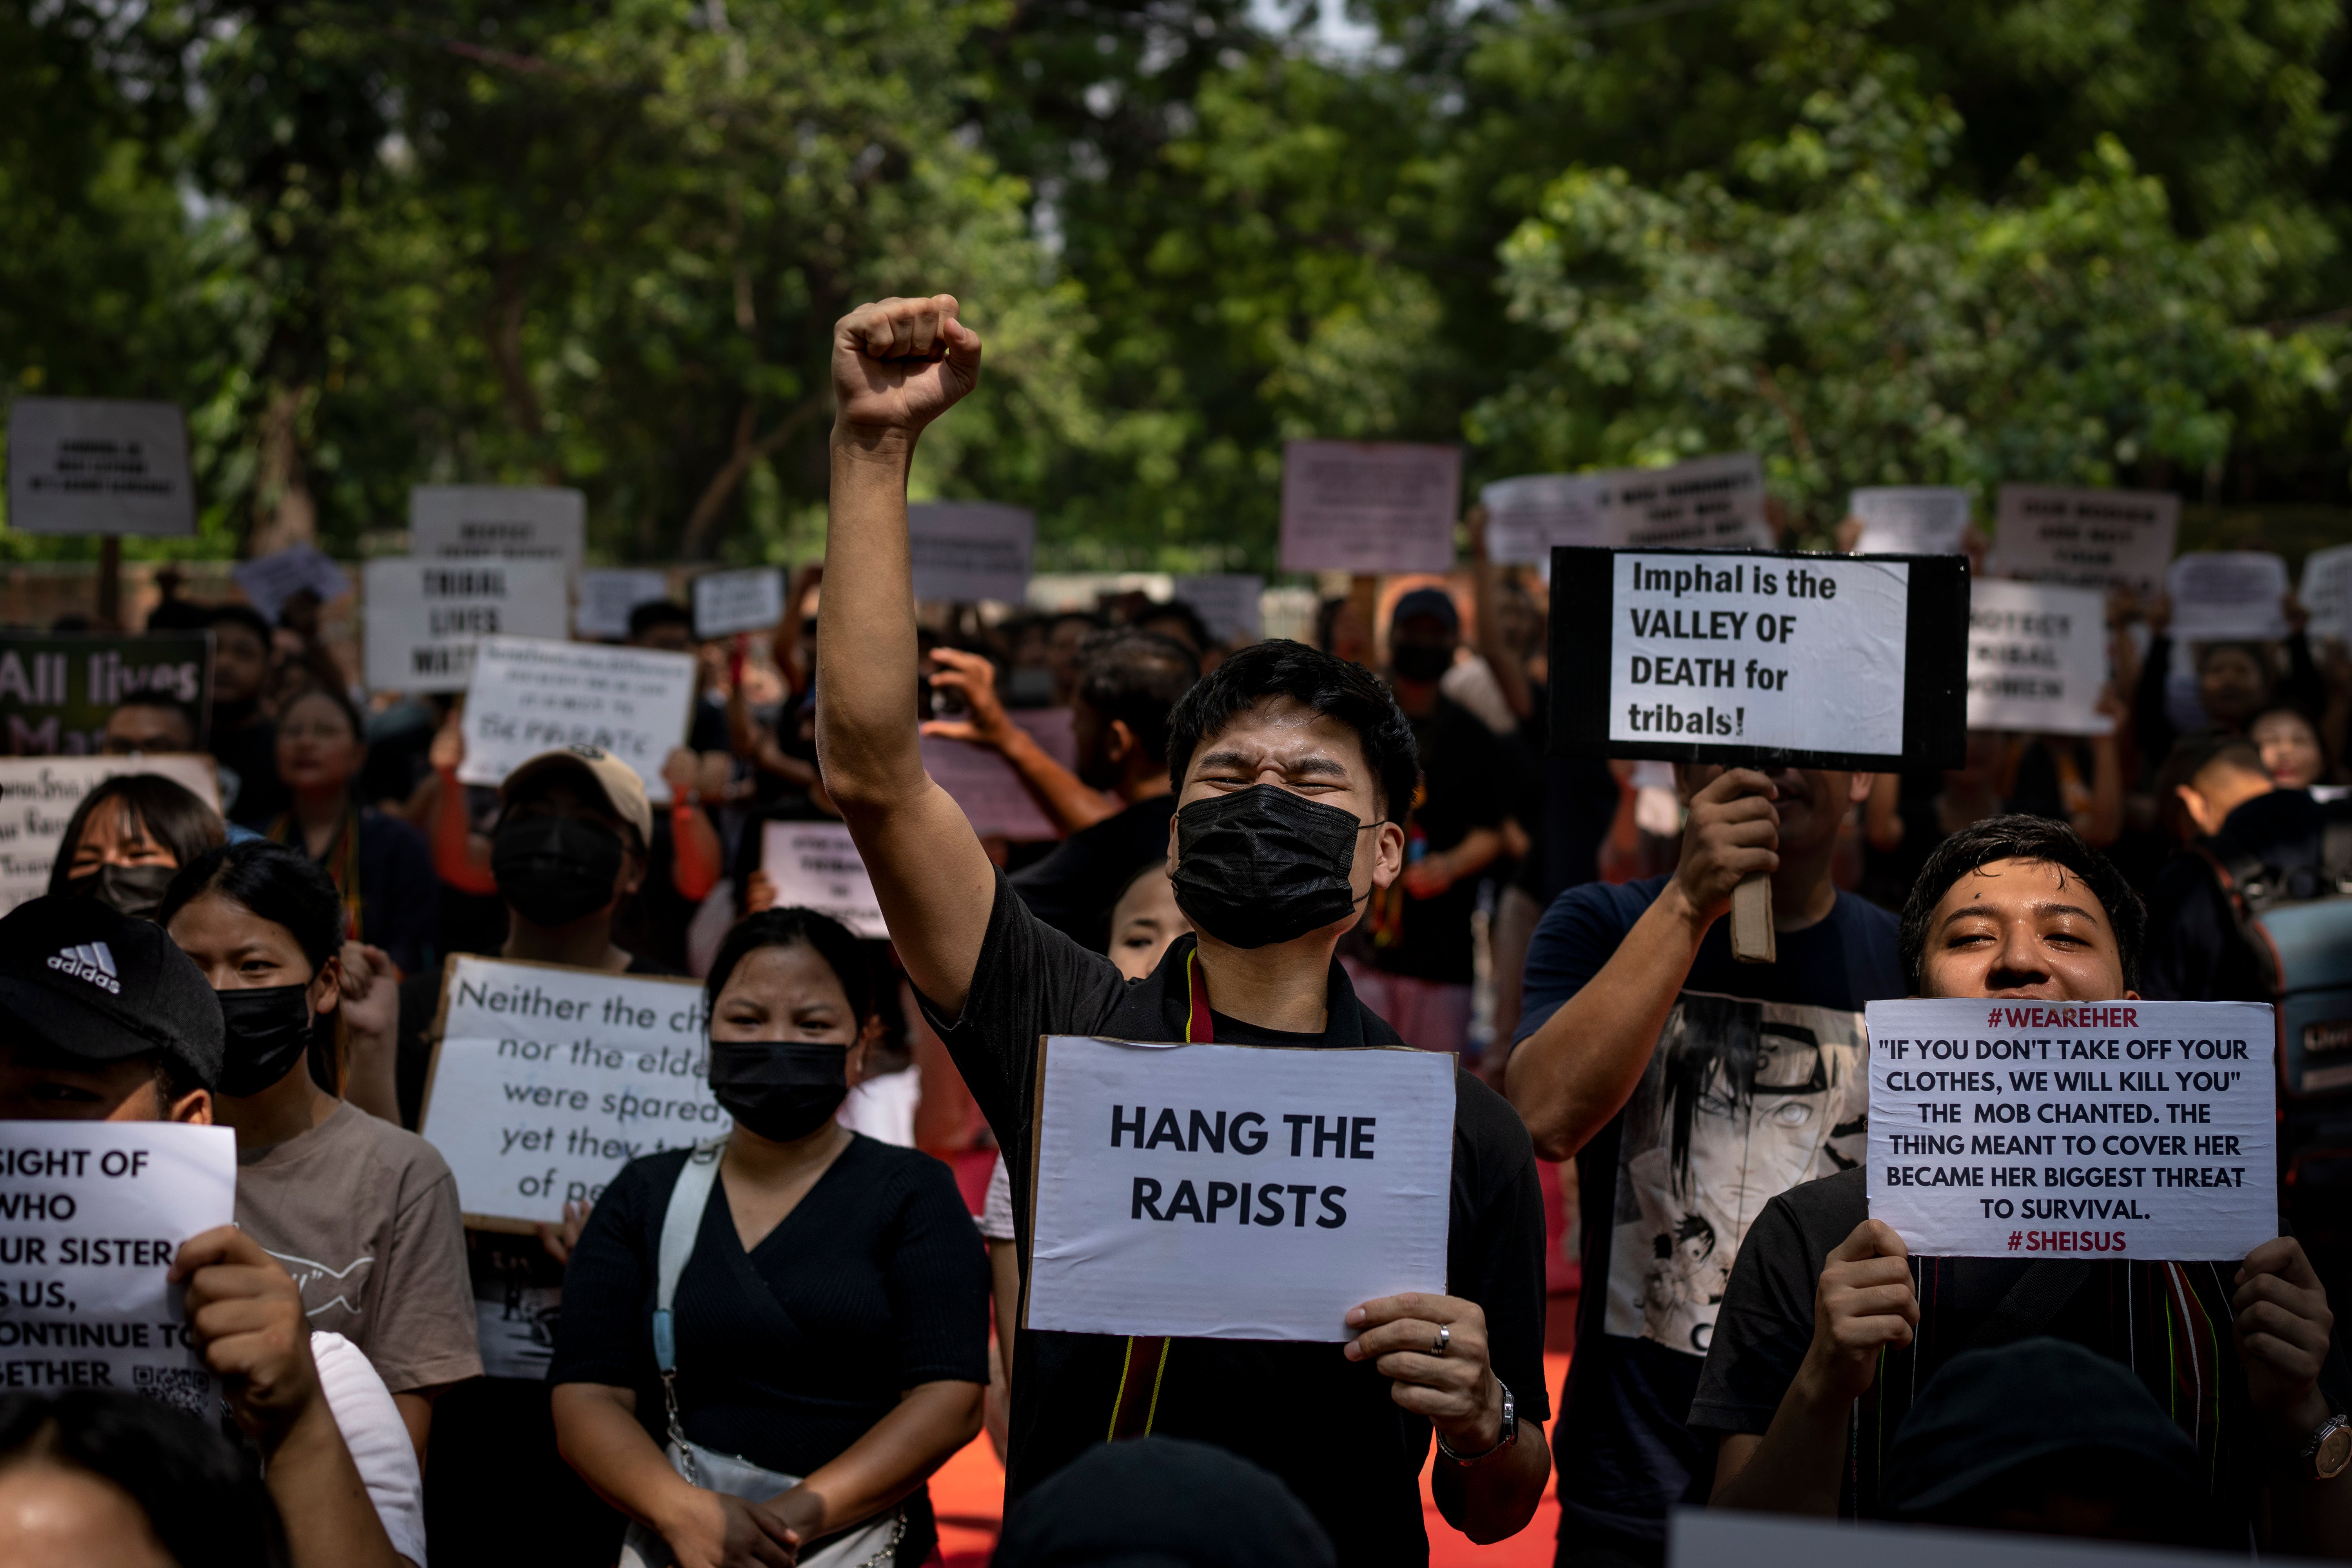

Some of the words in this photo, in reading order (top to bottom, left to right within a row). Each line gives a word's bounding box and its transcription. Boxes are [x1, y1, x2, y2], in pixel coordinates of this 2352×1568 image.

[1633, 562, 1743, 598] Imphal
[1753, 565, 1778, 595] is
[1786, 569, 1836, 599] the
[430, 608, 500, 637] LIVES
[1630, 608, 1748, 640] VALLEY
[1756, 613, 1797, 644] OF
[1970, 612, 2071, 638] ROTECT
[0, 650, 67, 704] All
[89, 649, 198, 702] lives
[1631, 656, 1735, 688] DEATH
[1745, 659, 1788, 691] for
[1968, 679, 2063, 698] OMEN
[1628, 704, 1745, 736] tribals!
[46, 956, 121, 995] adidas
[457, 979, 592, 1021] Neither
[602, 994, 656, 1029] the
[1988, 1007, 2139, 1028] #WEAREHER
[497, 1037, 558, 1062] nor
[570, 1037, 624, 1069] the
[1879, 1039, 1909, 1060] "IF
[1915, 1040, 1968, 1060] YOU
[1976, 1039, 2051, 1060] DON'T
[2056, 1040, 2119, 1060] TAKE
[2126, 1039, 2172, 1060] OFF
[2178, 1039, 2249, 1060] YOUR
[504, 1082, 589, 1111] were
[1886, 1071, 2002, 1095] CLOTHES,
[2009, 1071, 2047, 1091] WE
[2054, 1072, 2112, 1091] WILL
[2120, 1072, 2170, 1091] KILL
[2175, 1071, 2241, 1092] YOU"
[1917, 1103, 1961, 1123] THE
[1974, 1103, 2031, 1123] MOB
[2037, 1103, 2160, 1124] CHANTED.
[2166, 1103, 2210, 1123] THE
[500, 1126, 556, 1156] yet
[1111, 1105, 1269, 1155] HANG
[1283, 1114, 1376, 1160] THE
[1889, 1134, 1965, 1155] THING
[1971, 1135, 2056, 1155] MEANT
[2062, 1135, 2096, 1156] TO
[2102, 1135, 2188, 1156] COVER
[2194, 1135, 2241, 1155] HER
[0, 1149, 91, 1176] IGHT
[101, 1151, 149, 1177] OF
[1887, 1166, 1984, 1187] BECAME
[1991, 1167, 2038, 1187] HER
[2045, 1167, 2146, 1187] BIGGEST
[2152, 1167, 2245, 1188] THREAT
[518, 1167, 557, 1198] of
[1131, 1177, 1347, 1229] RAPISTS
[1980, 1198, 2014, 1219] TO
[2021, 1199, 2150, 1220] SURVIVAL.
[0, 1238, 46, 1264] UR
[60, 1238, 186, 1267] SISTER
[2007, 1231, 2126, 1252] #SHEISUS
[20, 1281, 76, 1314] US,
[0, 1321, 150, 1348] ONTINUE
[0, 1360, 112, 1388] ETHER
